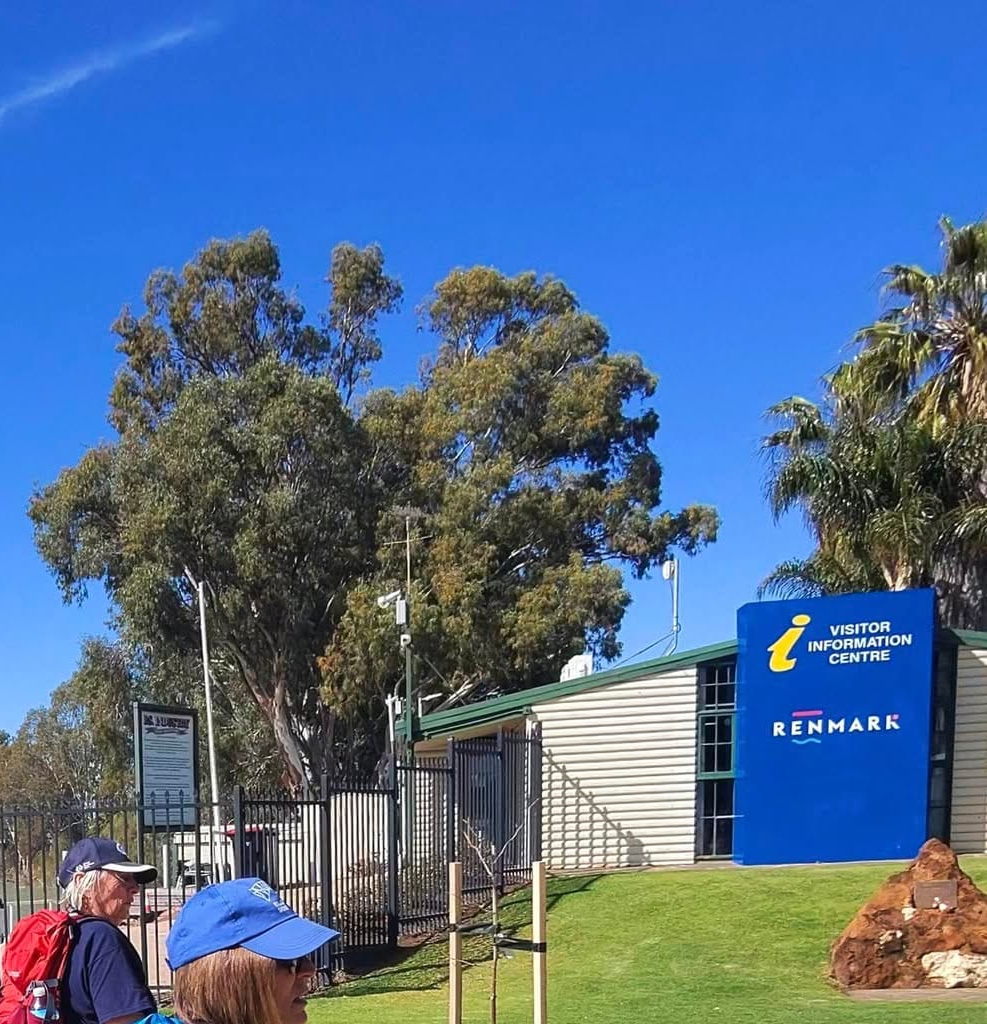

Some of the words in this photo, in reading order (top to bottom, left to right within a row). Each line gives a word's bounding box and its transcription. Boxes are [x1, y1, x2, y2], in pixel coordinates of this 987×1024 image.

[830, 621, 891, 636] VISITOR
[808, 634, 912, 652] INFORMATION
[829, 650, 891, 664] CENTRE
[773, 714, 900, 737] RENMARK
